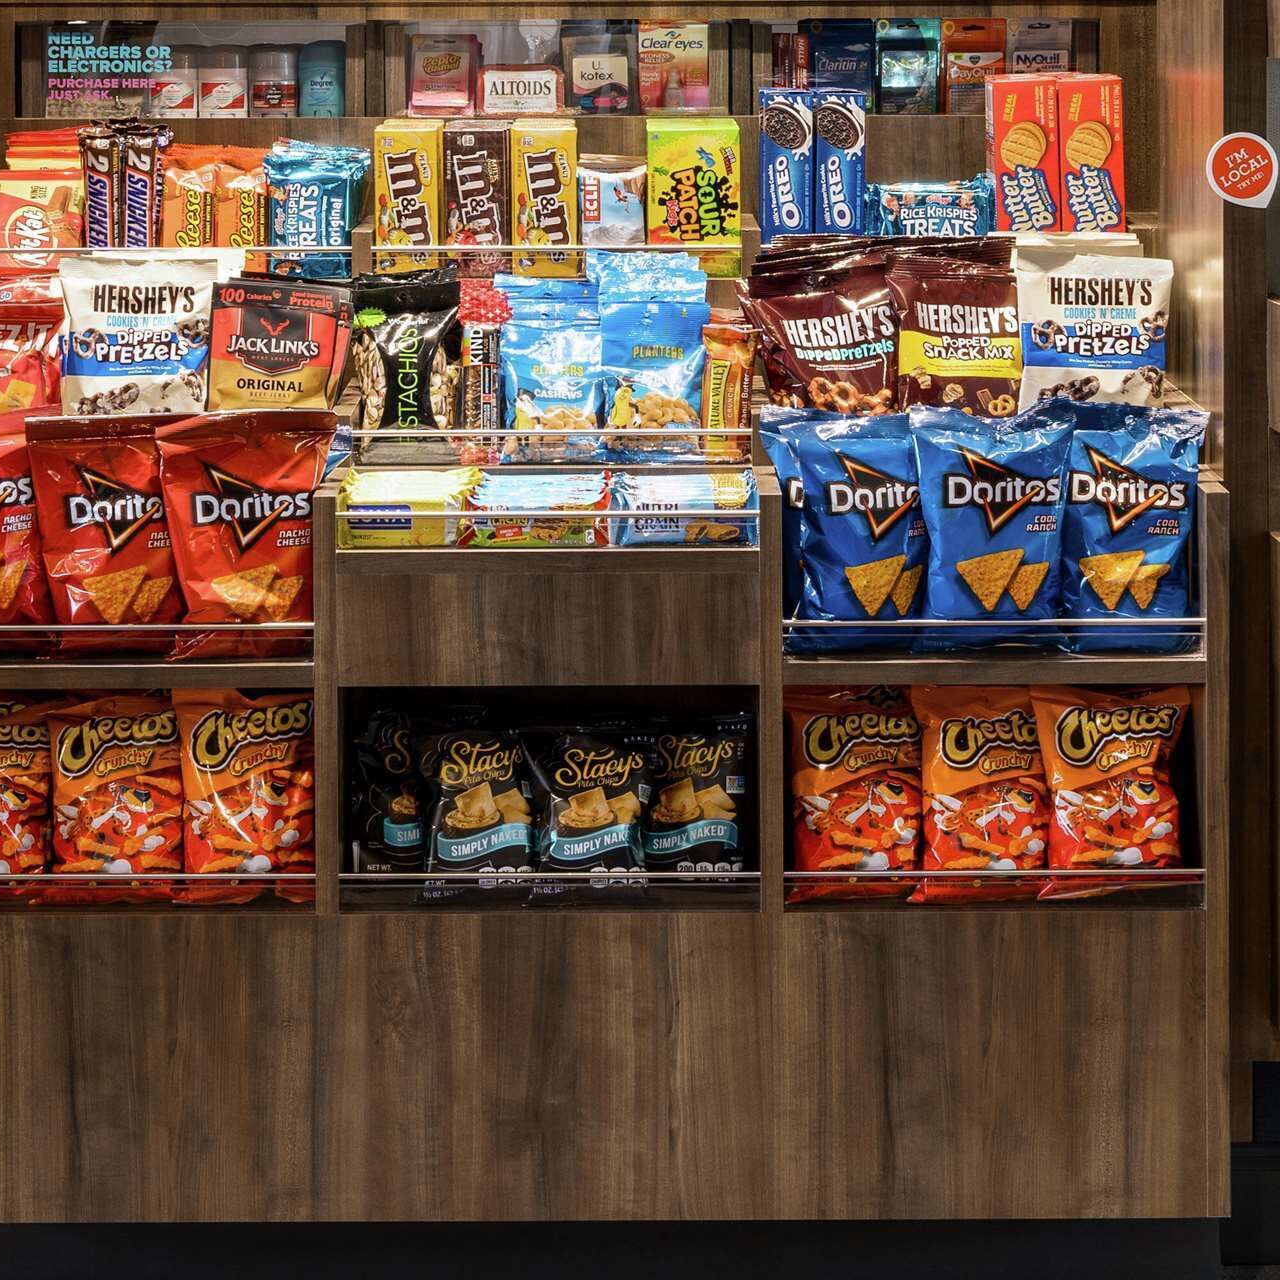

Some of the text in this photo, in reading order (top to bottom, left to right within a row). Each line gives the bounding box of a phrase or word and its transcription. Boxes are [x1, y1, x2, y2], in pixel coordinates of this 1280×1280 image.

[48, 32, 94, 45] NEED
[641, 38, 704, 51] Clear eyes
[48, 46, 171, 59] CHARGERS OR
[820, 57, 856, 71] Claritin
[1016, 53, 1060, 66] NyQuil
[48, 60, 173, 73] ELECTRONICS?
[580, 71, 614, 81] kotex
[48, 78, 161, 90] PURCHASE HERE.
[310, 80, 333, 89] Degree
[489, 80, 552, 96] ALTOIDS
[1225, 148, 1249, 168] I'M
[1219, 154, 1269, 188] LOCAL
[697, 170, 721, 236] SOUR
[770, 184, 778, 208] Favorite
[776, 155, 801, 228] OREO
[821, 184, 830, 208] Favorite
[827, 155, 853, 228] OREO
[1016, 166, 1053, 228] Butter
[1081, 166, 1119, 228] Butter
[286, 183, 301, 233] KRISPIES
[672, 169, 701, 241] PATCH
[900, 206, 978, 221] RICE KRISPIES
[329, 197, 344, 245] original
[902, 219, 976, 237] TREATS
[93, 284, 195, 315] HERSHEY'S
[220, 288, 245, 303] 100
[289, 296, 334, 309] Protein
[1049, 276, 1153, 306] HERSHEY'S
[107, 315, 138, 327] COOKIES
[915, 301, 1019, 335] HERSHEY'S
[1064, 308, 1137, 320] COOKIES CREME
[783, 305, 895, 348] HERSHEY'S
[227, 335, 319, 356] JACK LINK'S
[470, 327, 483, 365] KIND
[632, 345, 684, 360] PLANTERS
[237, 378, 304, 393] ORIGINAL
[711, 362, 727, 397] VALLEY
[533, 388, 583, 400] CASHEWS
[739, 400, 748, 429] Peanut
[828, 481, 919, 513] Dorito
[947, 475, 1061, 506] Doritos
[1069, 471, 1186, 510] Doritos
[3, 513, 33, 524] NACHO
[68, 496, 165, 524] Dorito
[193, 492, 311, 524] Doritos
[1033, 514, 1057, 524] COOL
[1, 522, 33, 533] CHEESE
[278, 528, 311, 538] NACHO
[1026, 522, 1057, 533] RANCH
[1147, 525, 1181, 536] RANCH
[1156, 519, 1181, 528] COOL
[276, 537, 311, 548] CHEESE
[58, 708, 177, 773] Cheetos
[193, 701, 313, 769] Cheetos
[804, 711, 918, 766] Cheetos
[941, 714, 1037, 766] Cheeto
[1057, 705, 1178, 765] Cheetos
[95, 747, 153, 777] Crunchy
[230, 742, 288, 776] Crunchy
[441, 740, 523, 784] Stacy's
[554, 748, 644, 787] Stacy's
[656, 734, 734, 778] Stacy's
[843, 747, 897, 771] Crunchy
[979, 753, 1030, 775] Crunchy
[1096, 740, 1153, 771] Crunchy
[483, 770, 505, 780] Chips
[577, 776, 619, 789] Pita Chips
[451, 829, 528, 857] SIMPLY NAKED
[563, 836, 601, 855] SIMPLY
[652, 825, 725, 849] SIMPLY NAKED
